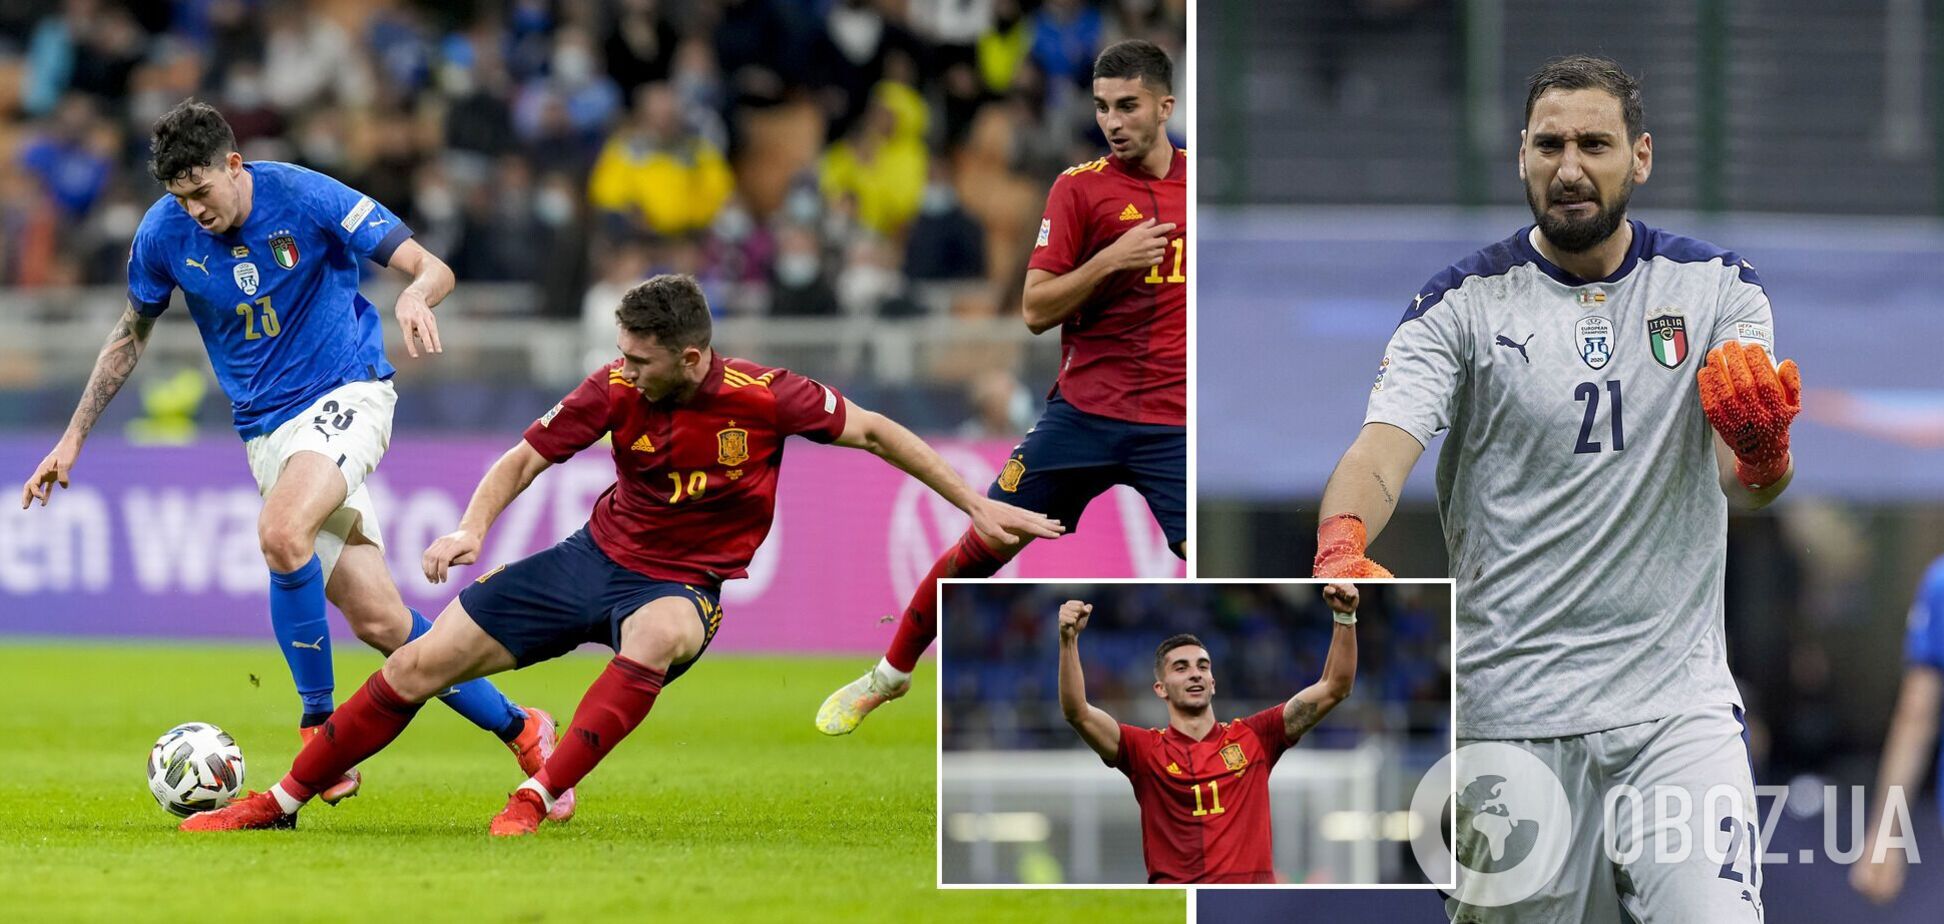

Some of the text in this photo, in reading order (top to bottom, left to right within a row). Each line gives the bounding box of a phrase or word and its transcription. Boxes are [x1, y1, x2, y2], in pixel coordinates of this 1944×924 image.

[236, 296, 281, 340] 23
[1649, 318, 1683, 330] ITALIA
[313, 400, 357, 430] 23
[1574, 380, 1624, 454] 21
[1191, 780, 1225, 816] 11
[1718, 816, 1756, 887] 21
